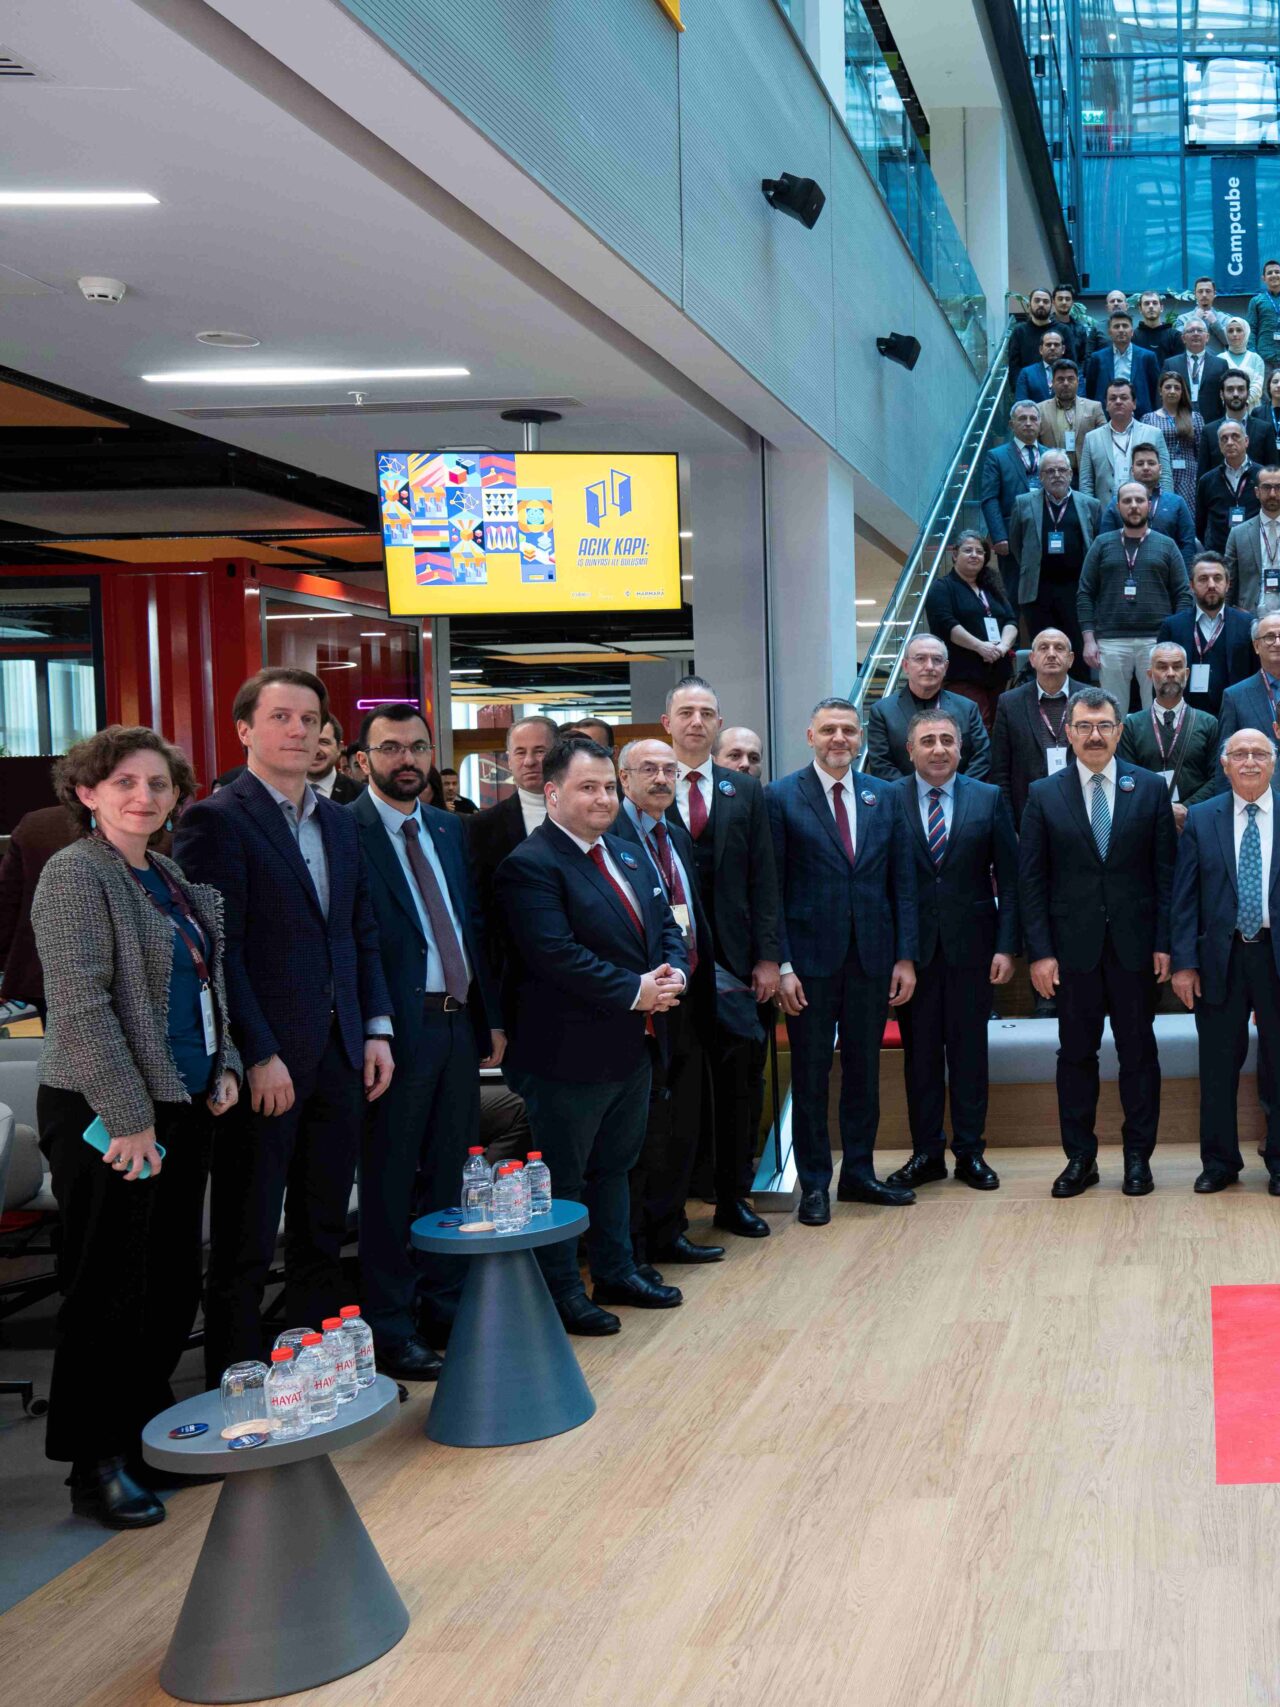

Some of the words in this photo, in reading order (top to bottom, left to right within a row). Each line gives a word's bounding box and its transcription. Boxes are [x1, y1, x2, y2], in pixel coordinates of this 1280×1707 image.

[1224, 177, 1246, 276] Campcube
[614, 537, 649, 556] KAPI:
[271, 1391, 302, 1406] HAYAT
